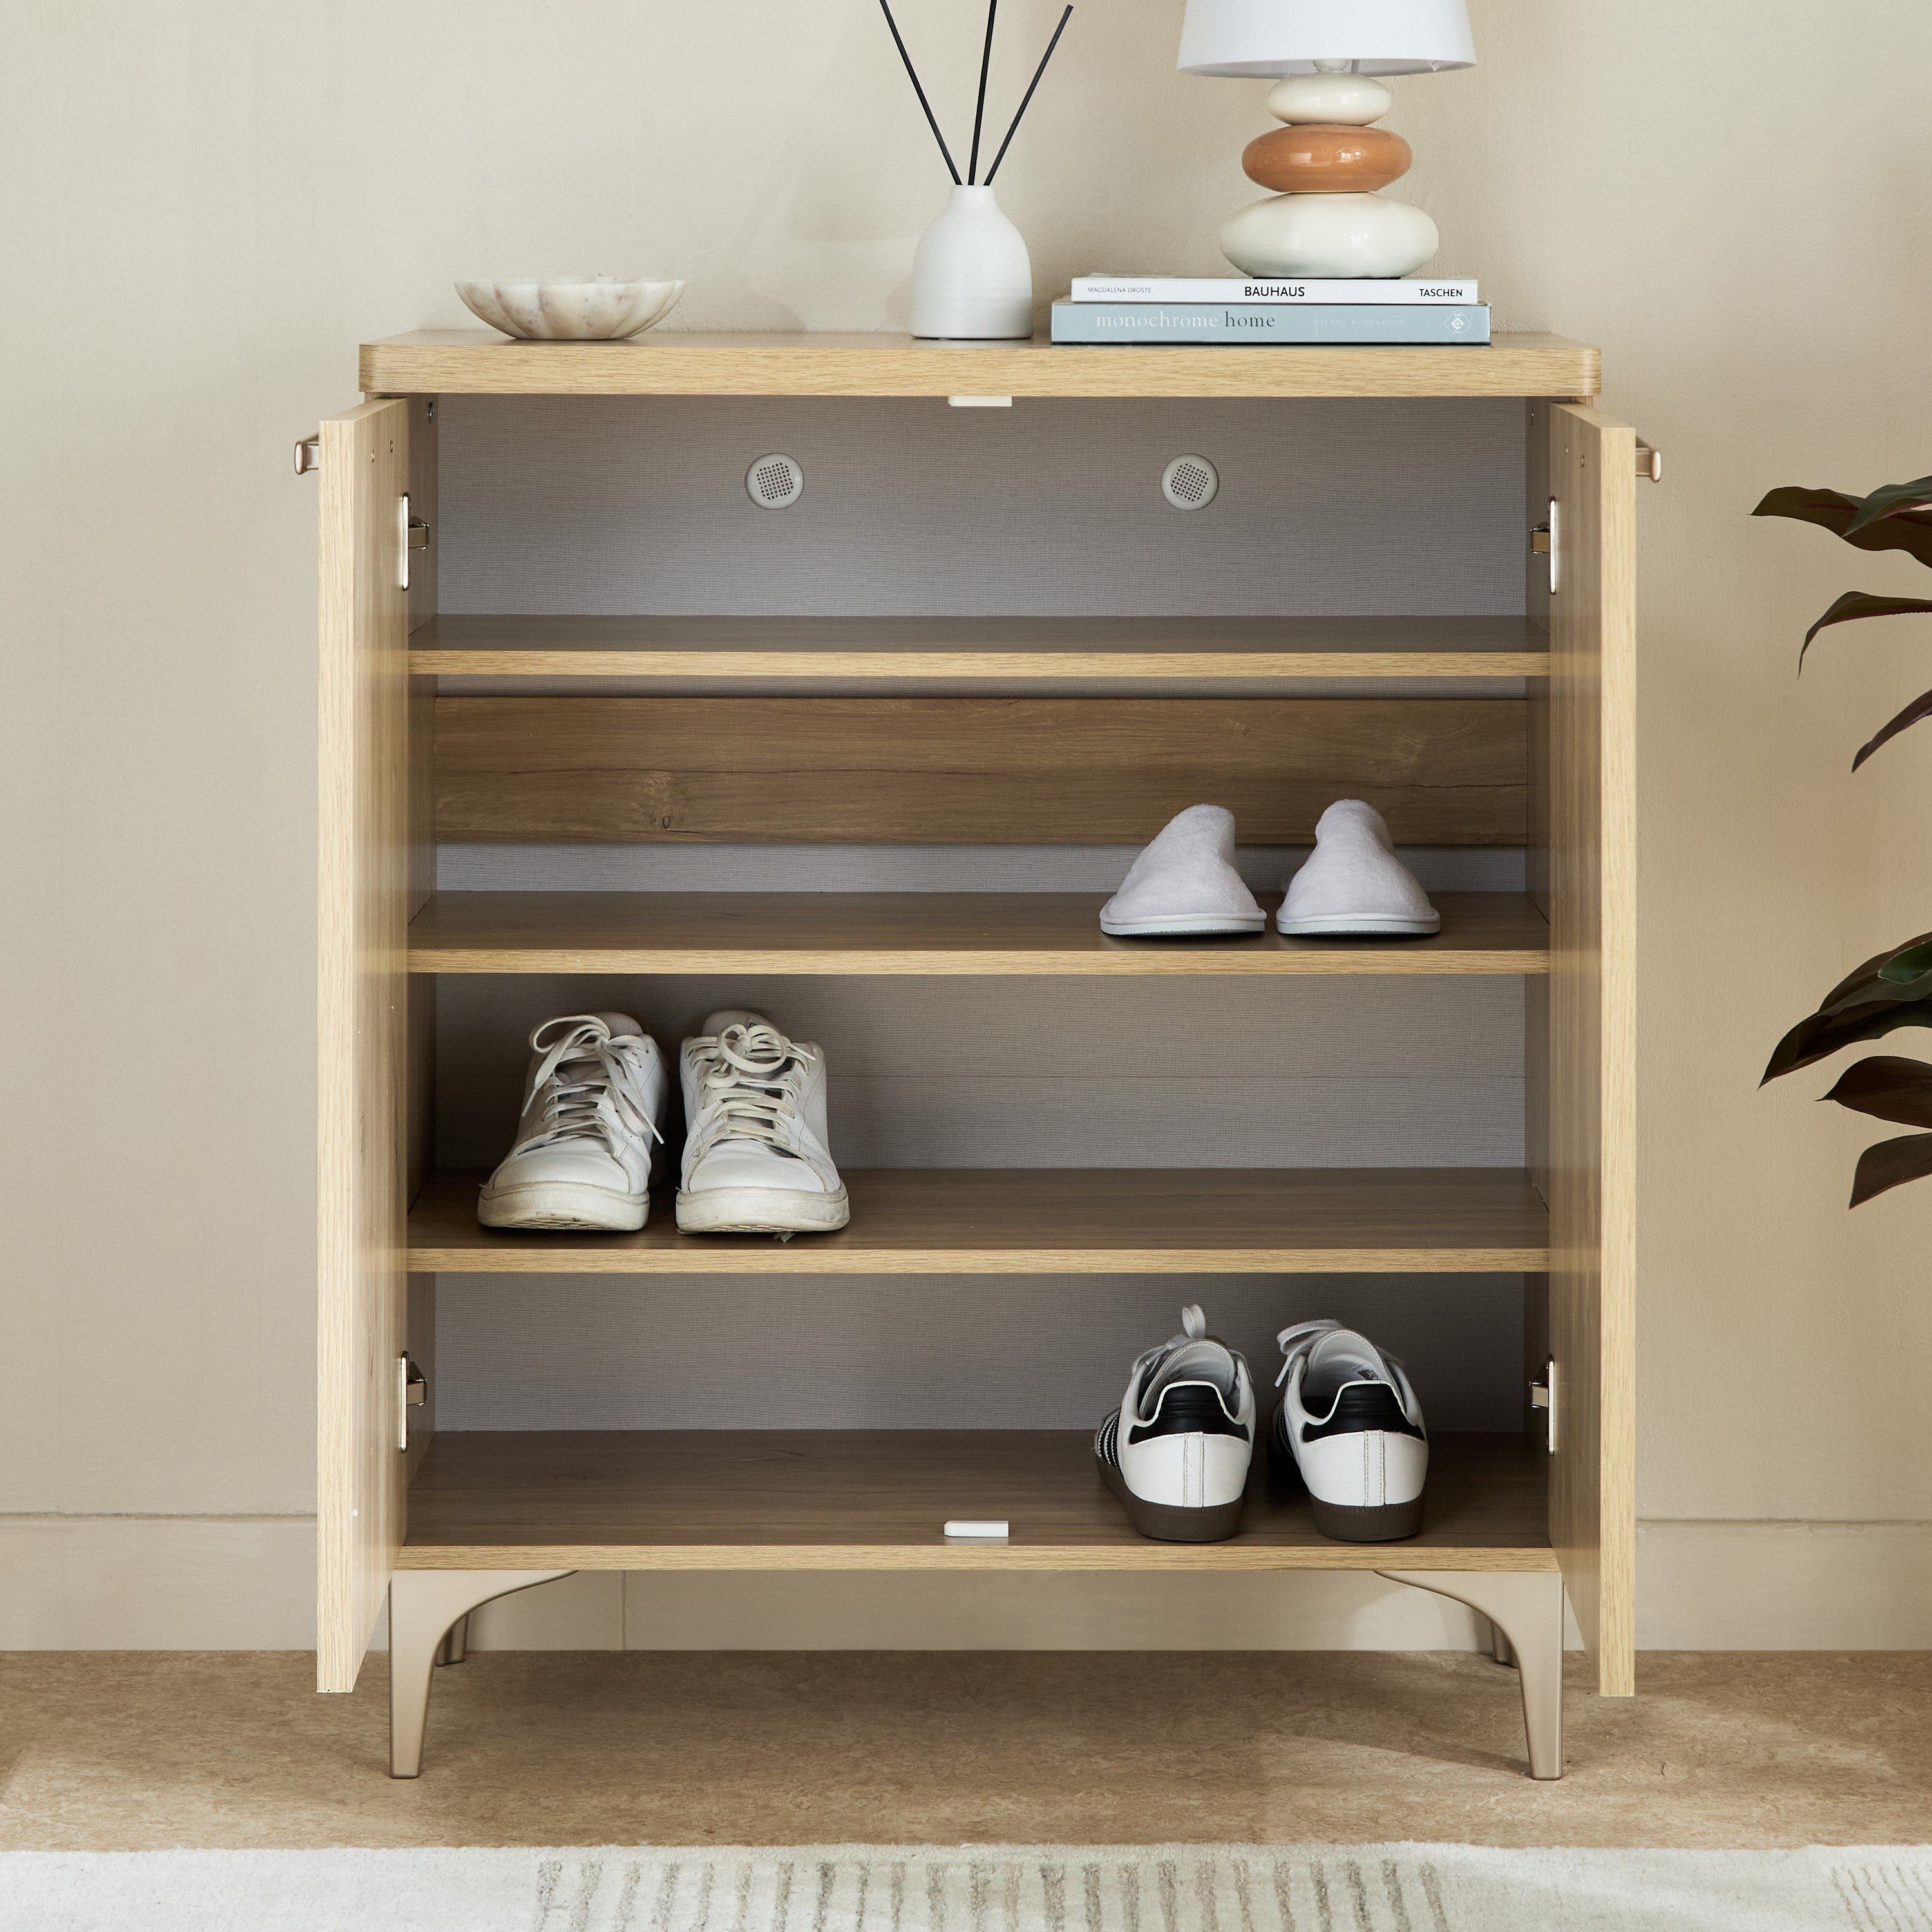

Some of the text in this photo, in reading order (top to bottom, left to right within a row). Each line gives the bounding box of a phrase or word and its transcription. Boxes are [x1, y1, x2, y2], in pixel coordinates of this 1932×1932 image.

[1244, 286, 1305, 297] BAUHAUS
[1419, 289, 1463, 297] TASCHEN
[1096, 310, 1275, 327] monochrome home
